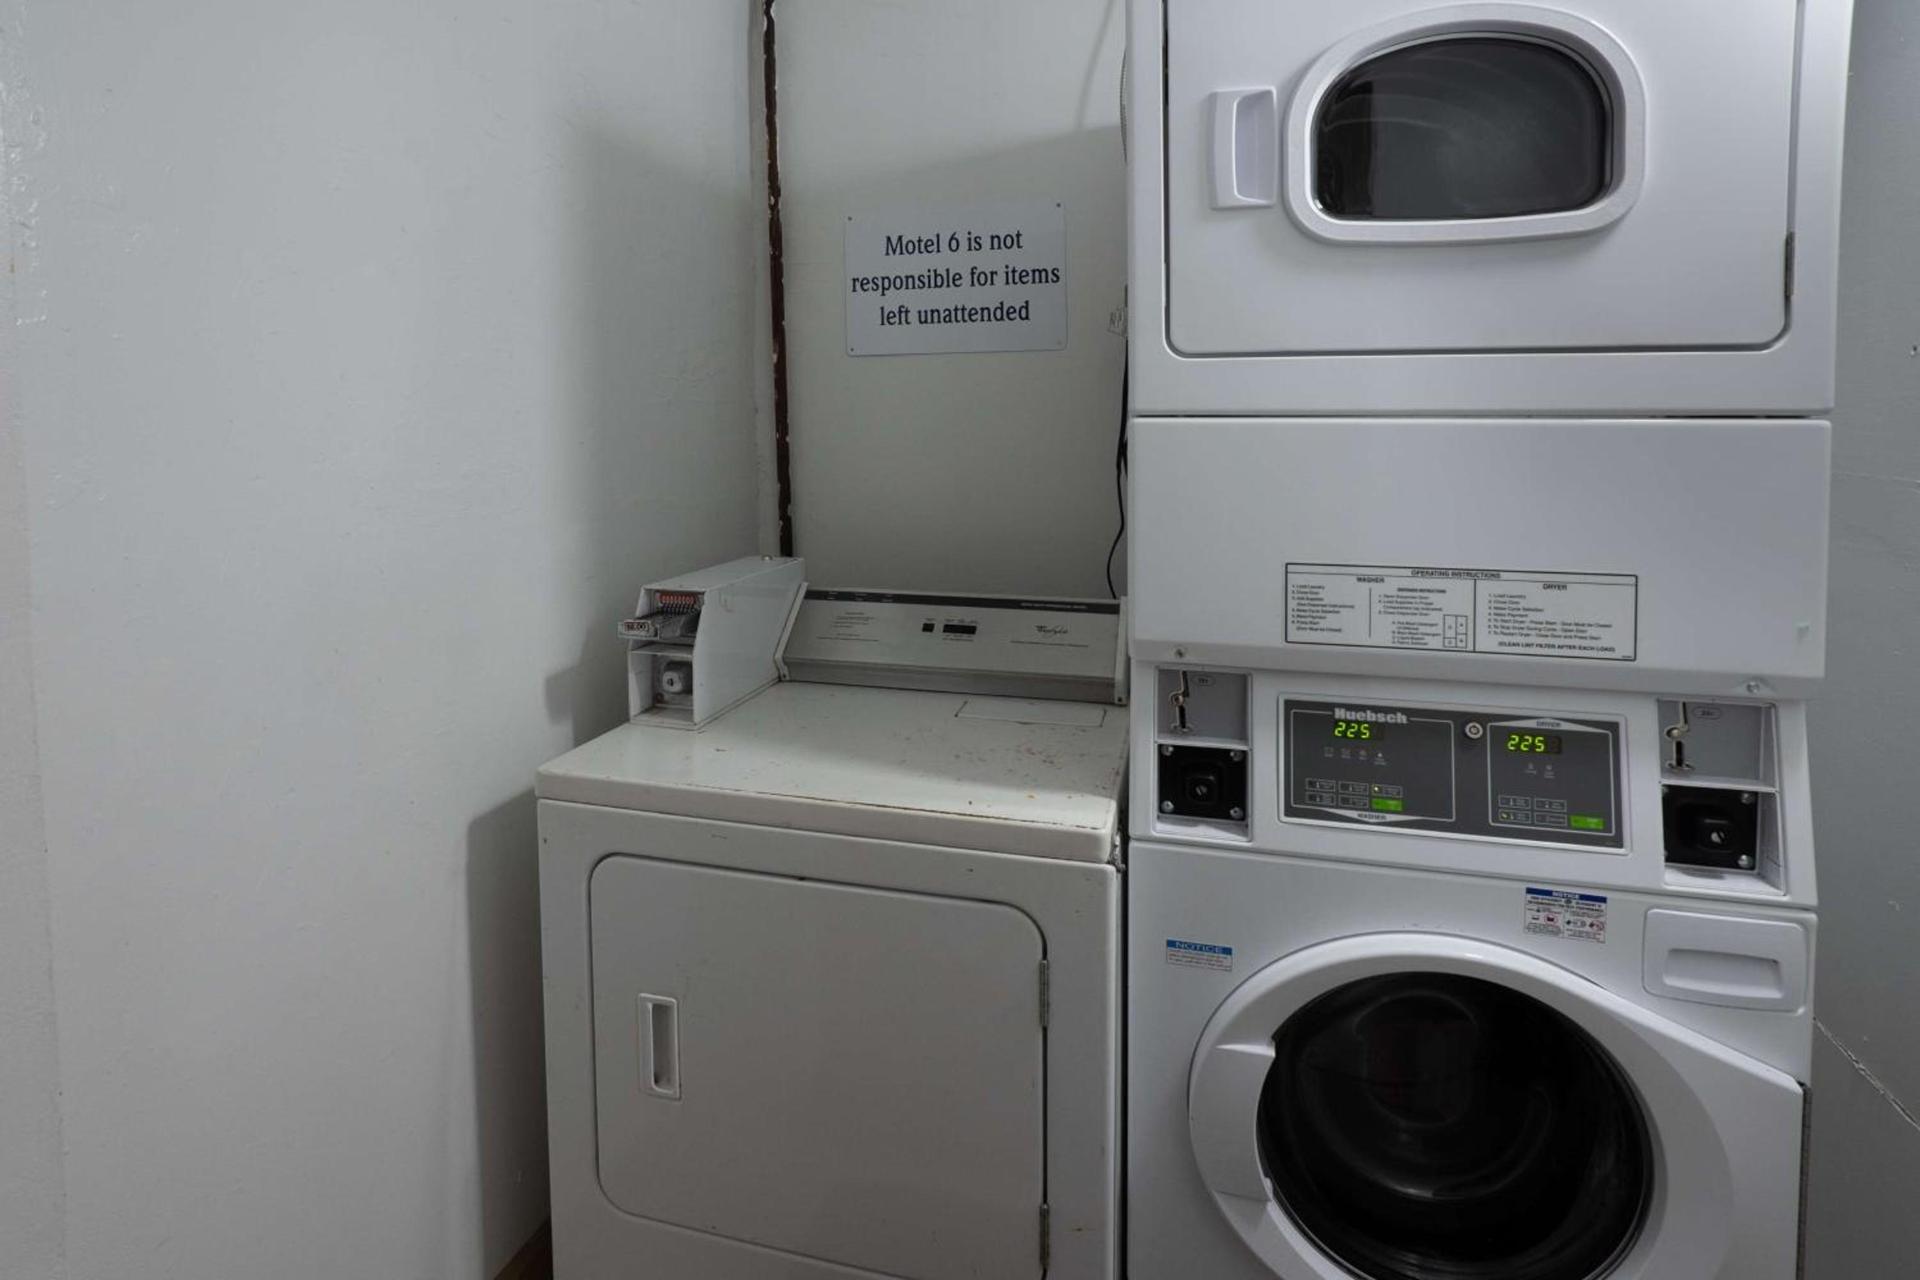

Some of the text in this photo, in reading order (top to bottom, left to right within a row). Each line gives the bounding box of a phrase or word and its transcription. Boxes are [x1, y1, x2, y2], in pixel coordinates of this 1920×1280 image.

[885, 230, 1023, 256] Motel 6 is not
[851, 264, 1060, 296] responsible for items
[880, 300, 1030, 326] left unattended
[1334, 708, 1408, 724] Huebsch
[1334, 722, 1370, 738] 225
[1507, 734, 1545, 752] 225
[1176, 942, 1224, 952] NOTICE
